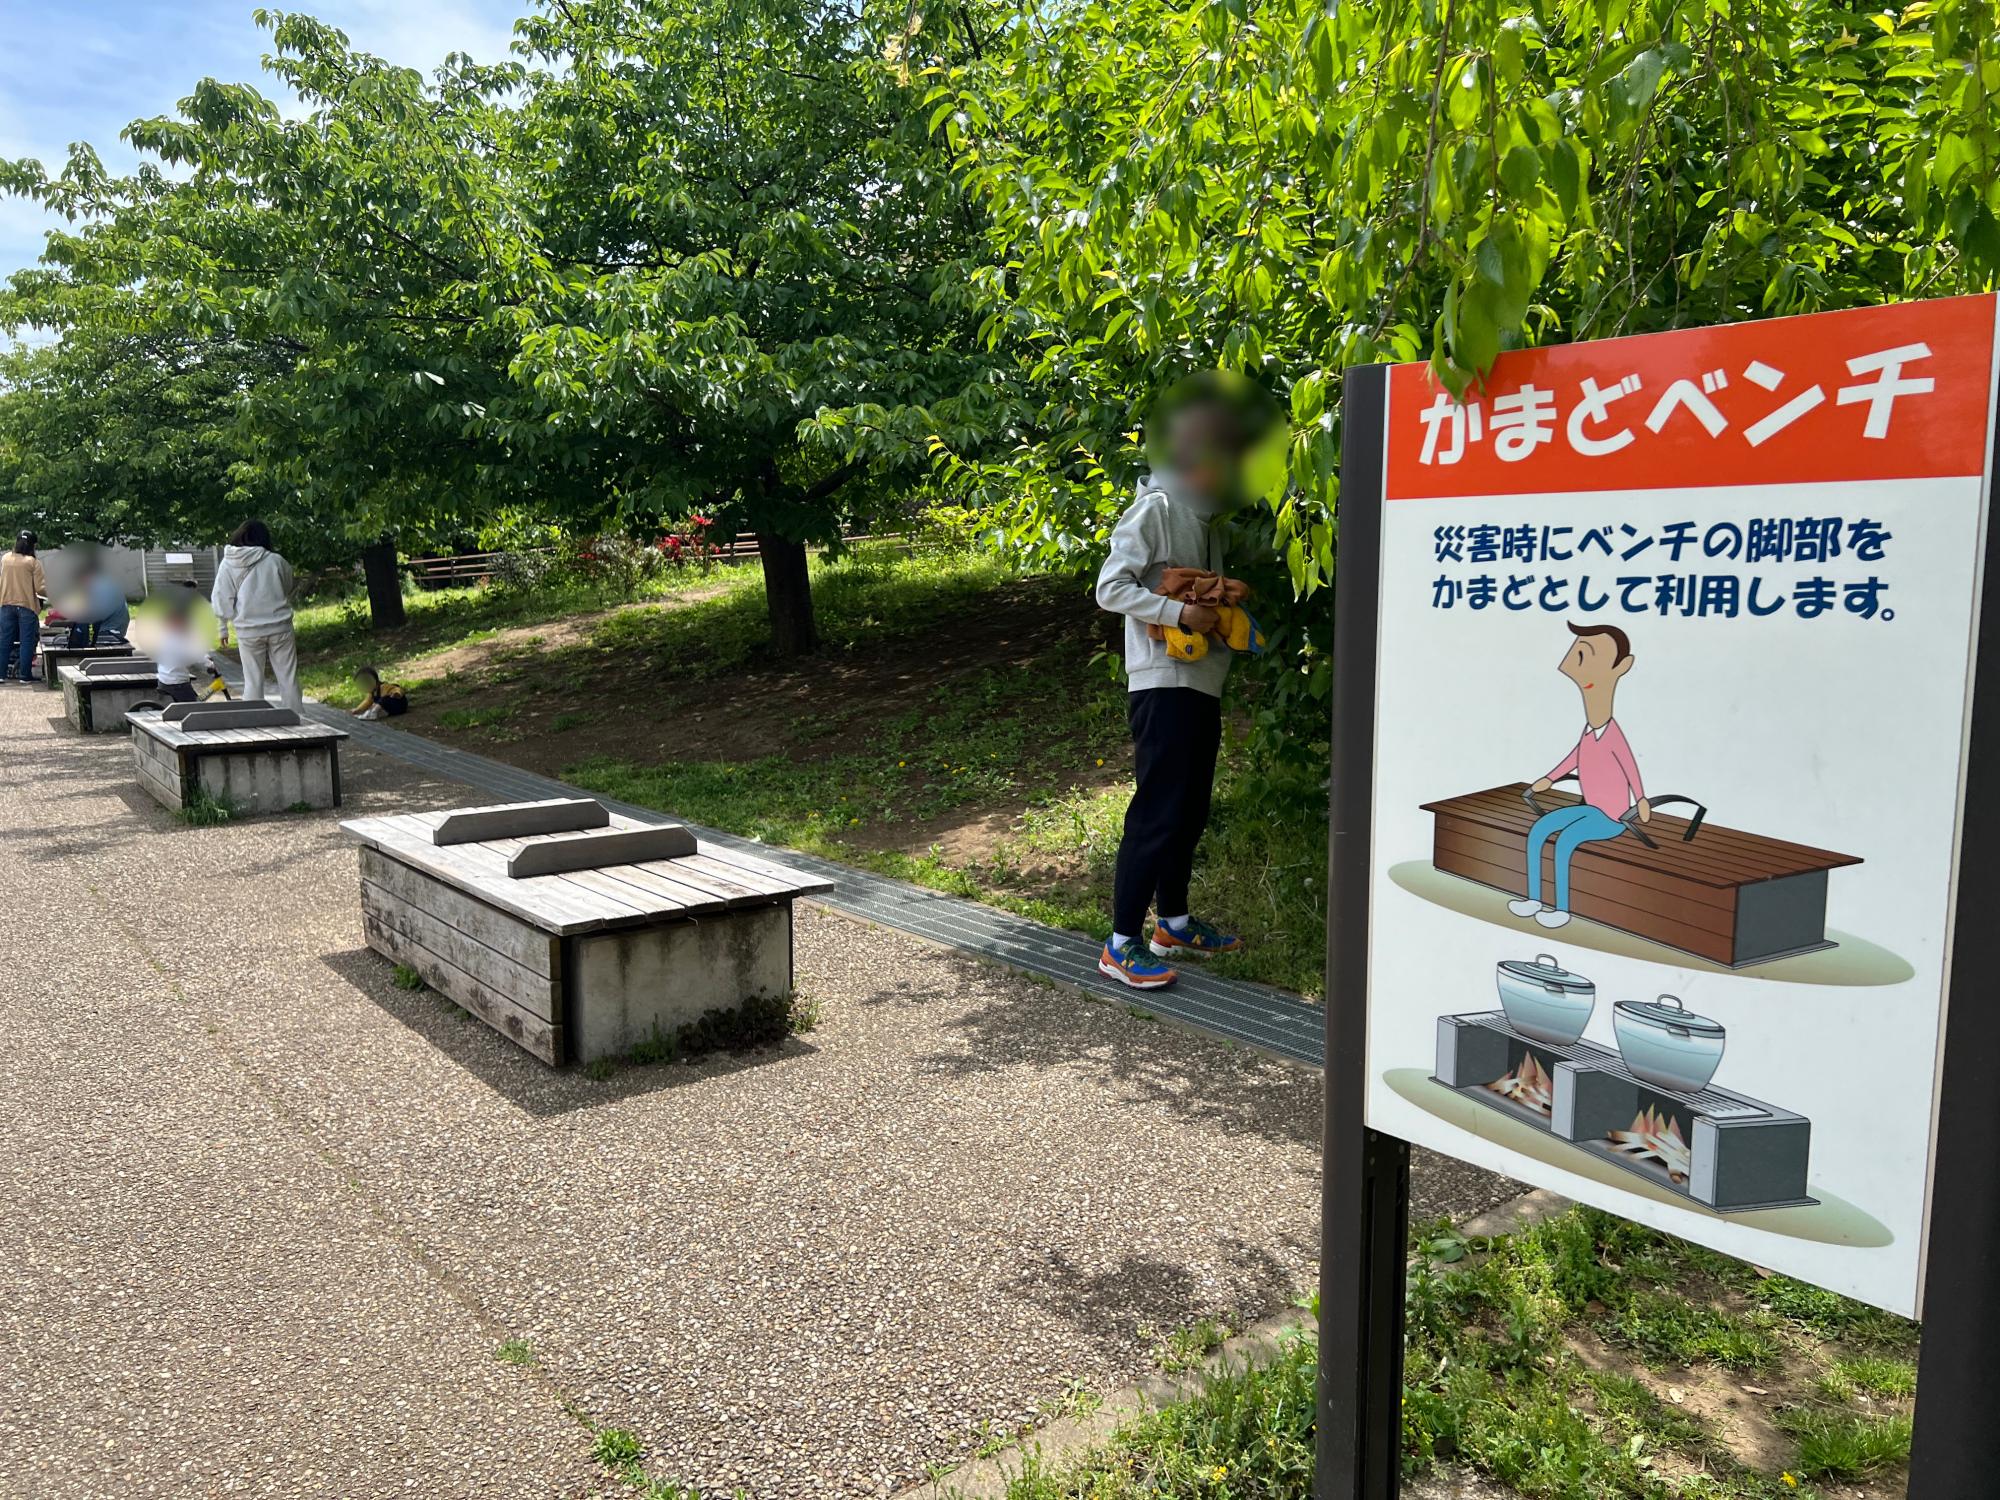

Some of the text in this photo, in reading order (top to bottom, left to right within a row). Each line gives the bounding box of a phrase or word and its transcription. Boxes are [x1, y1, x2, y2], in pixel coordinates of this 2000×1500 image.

[1419, 342, 1935, 466] かまどベンチ
[1433, 517, 1893, 563] 災害時にベンチの脚部を
[1432, 574, 1895, 622] かまどとして利用します。
